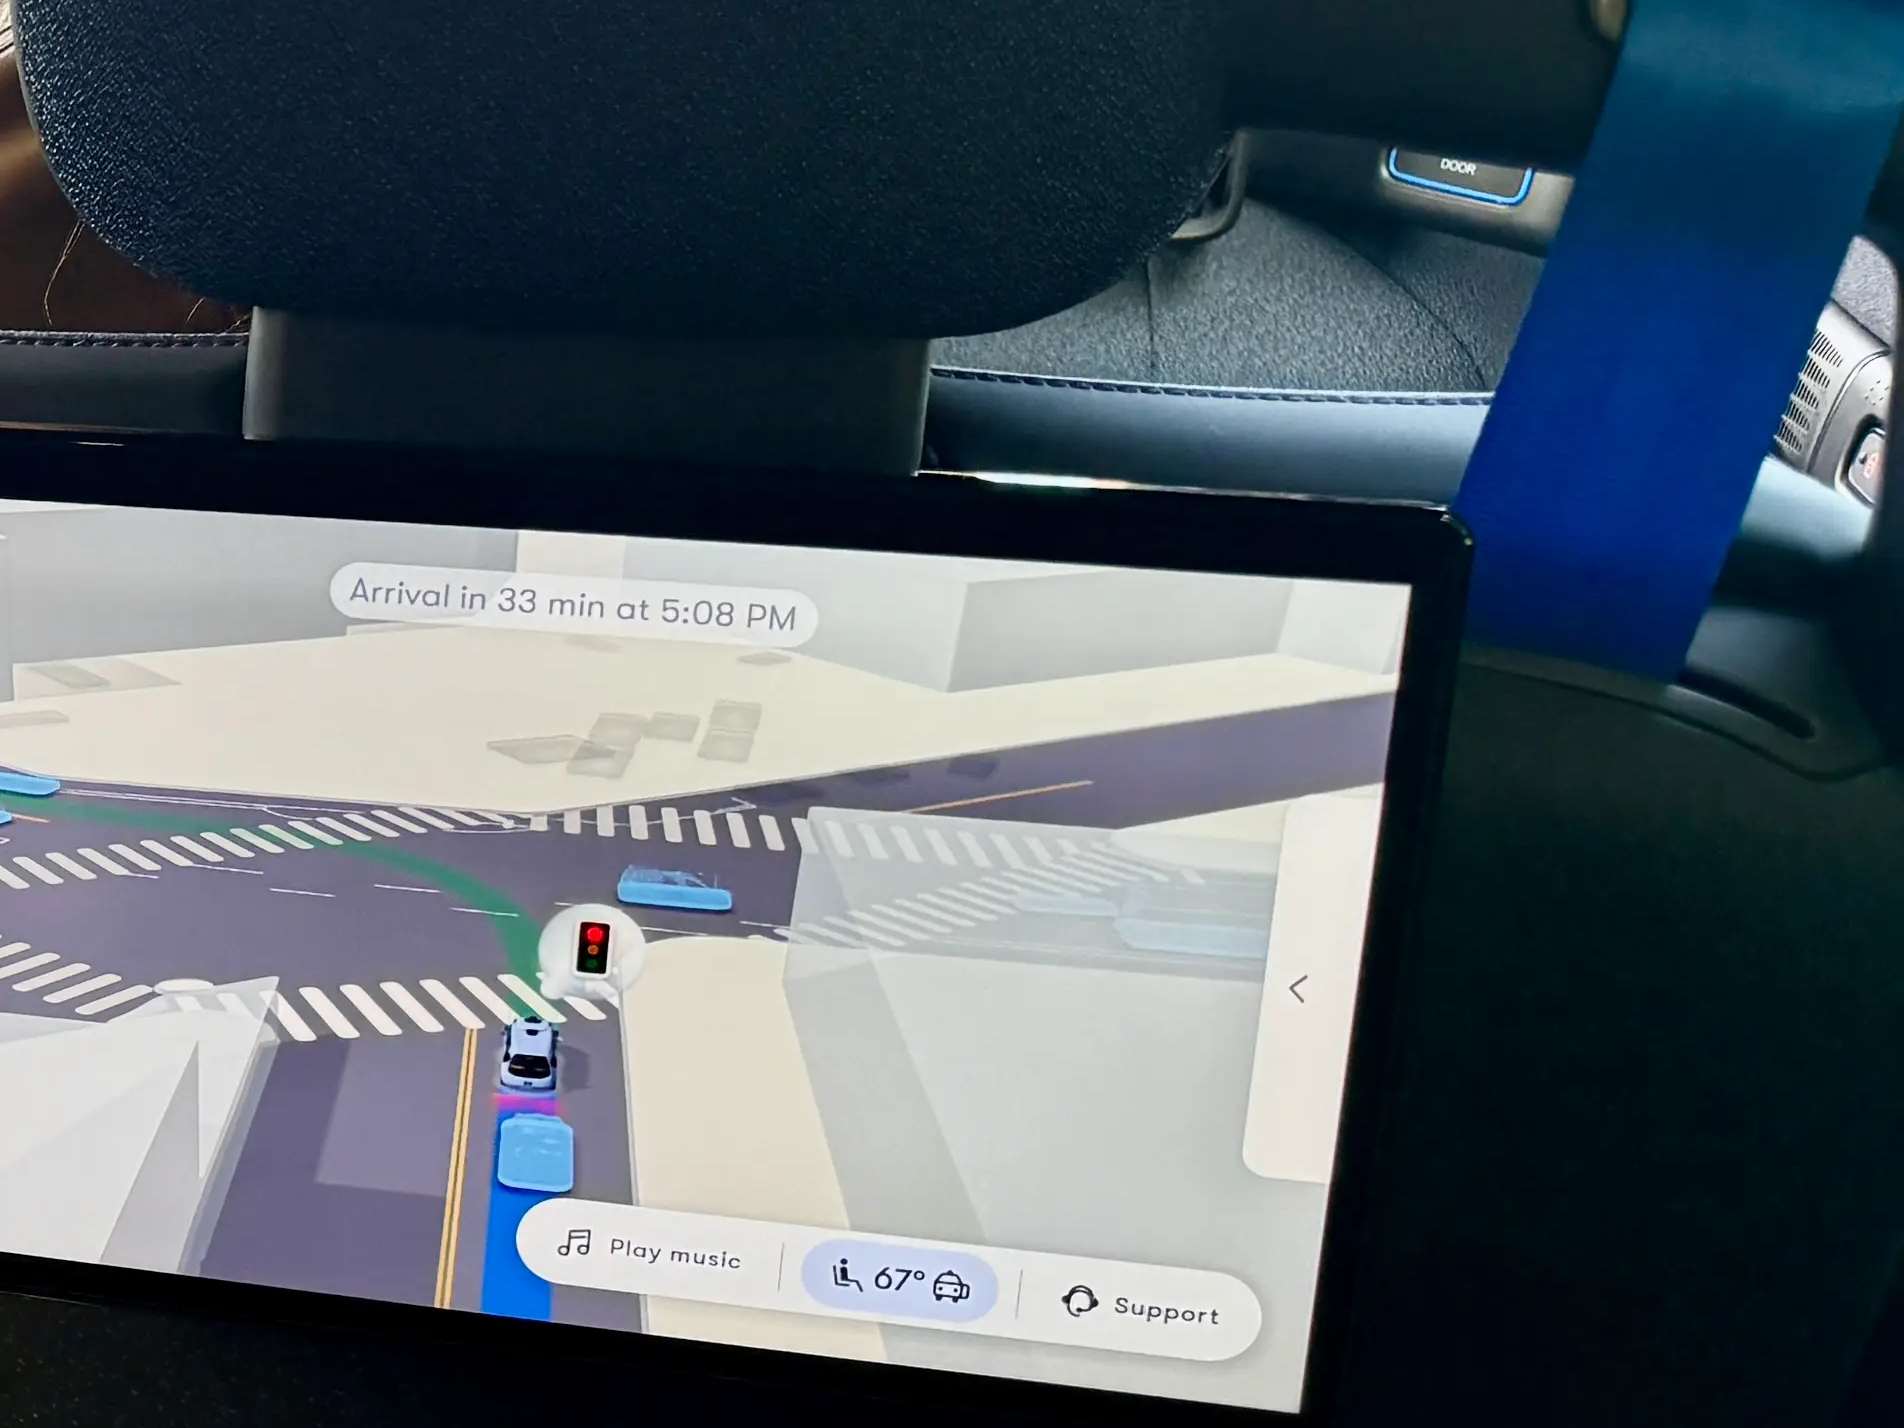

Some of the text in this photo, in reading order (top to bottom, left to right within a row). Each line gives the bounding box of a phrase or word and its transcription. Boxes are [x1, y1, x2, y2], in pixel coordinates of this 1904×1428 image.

[1440, 158, 1477, 176] DOOR
[349, 576, 797, 632] Arrival in 33 min at 5:08 PM
[609, 1237, 742, 1271] Play music
[873, 1265, 926, 1293] 67°
[1114, 1296, 1220, 1327] Support
